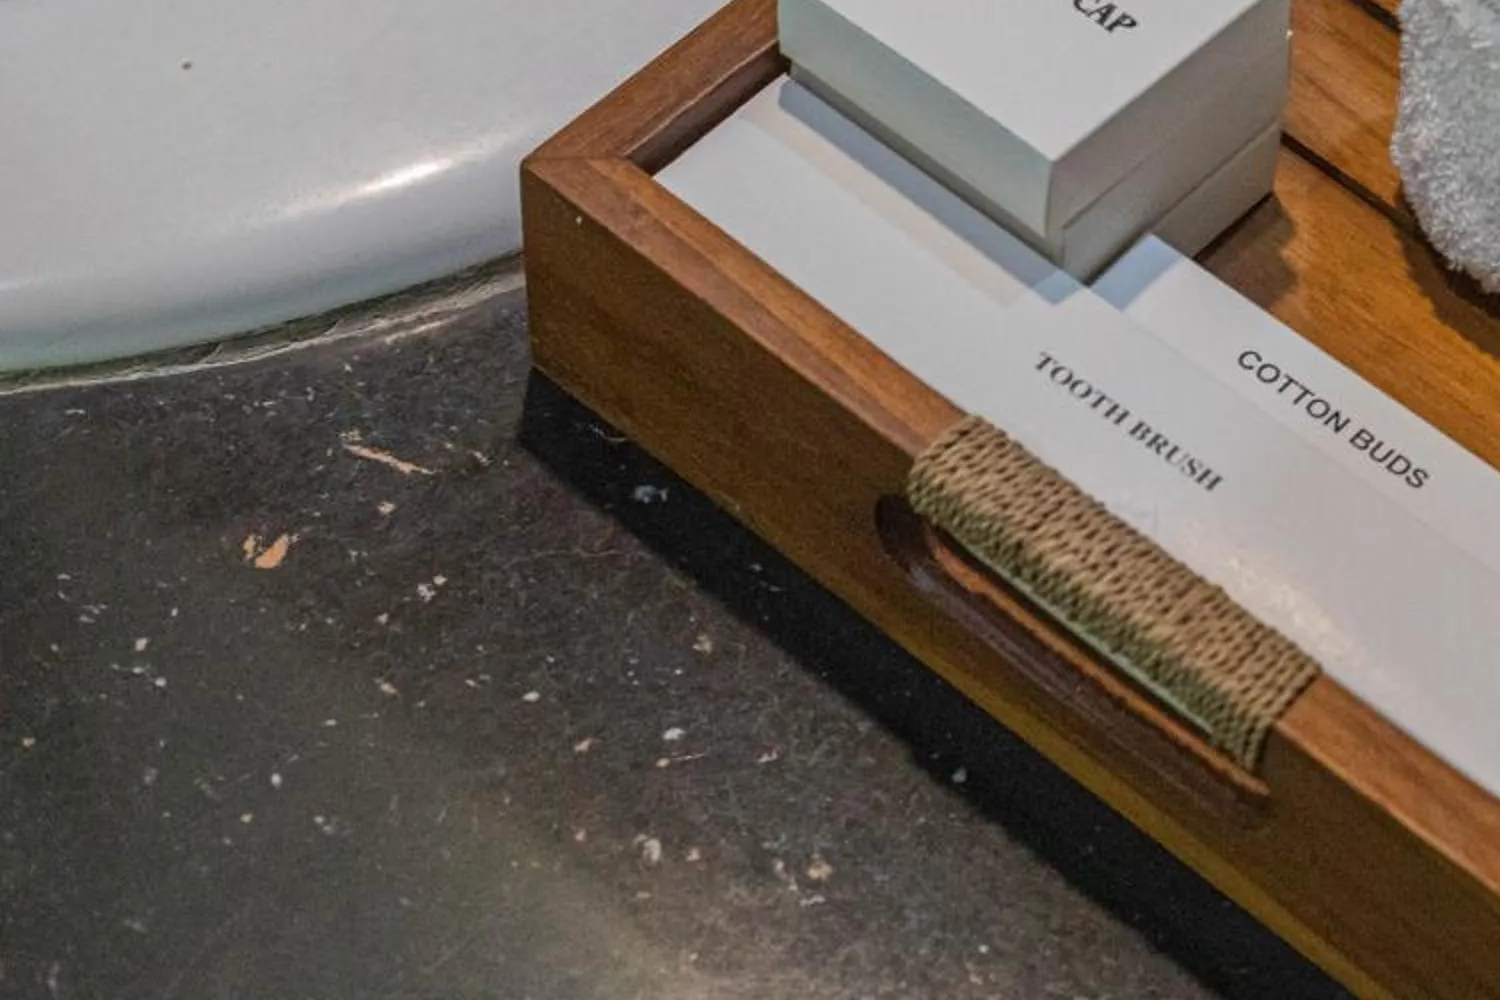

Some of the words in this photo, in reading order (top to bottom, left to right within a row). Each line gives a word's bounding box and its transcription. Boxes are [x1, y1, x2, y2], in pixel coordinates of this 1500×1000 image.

[1034, 352, 1131, 427] TOOTH
[1128, 420, 1224, 492] BRUSH
[1237, 349, 1351, 434] COTTON
[1349, 428, 1431, 490] BUDS
